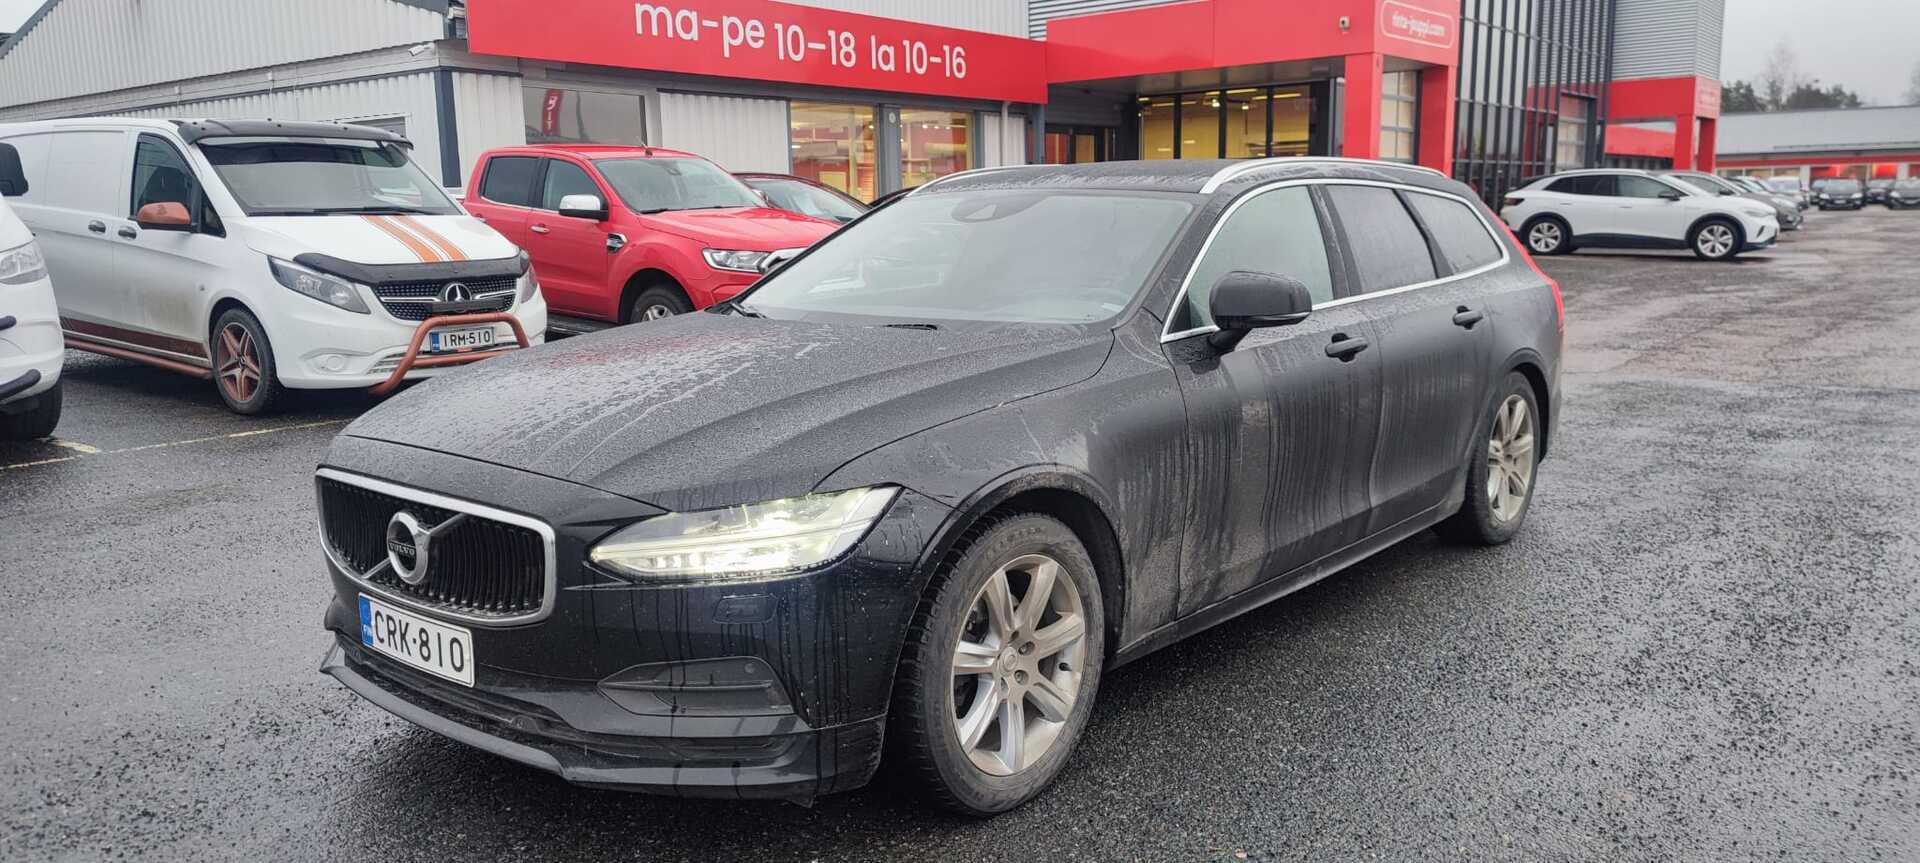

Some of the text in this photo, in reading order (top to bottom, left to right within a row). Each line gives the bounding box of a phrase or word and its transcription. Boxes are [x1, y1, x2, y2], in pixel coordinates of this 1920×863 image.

[635, 3, 967, 79] ma-pe 10-18 la 10-16
[444, 331, 490, 346] IRM-510
[389, 543, 416, 556] VOLVO
[374, 610, 464, 672] CRK-810
